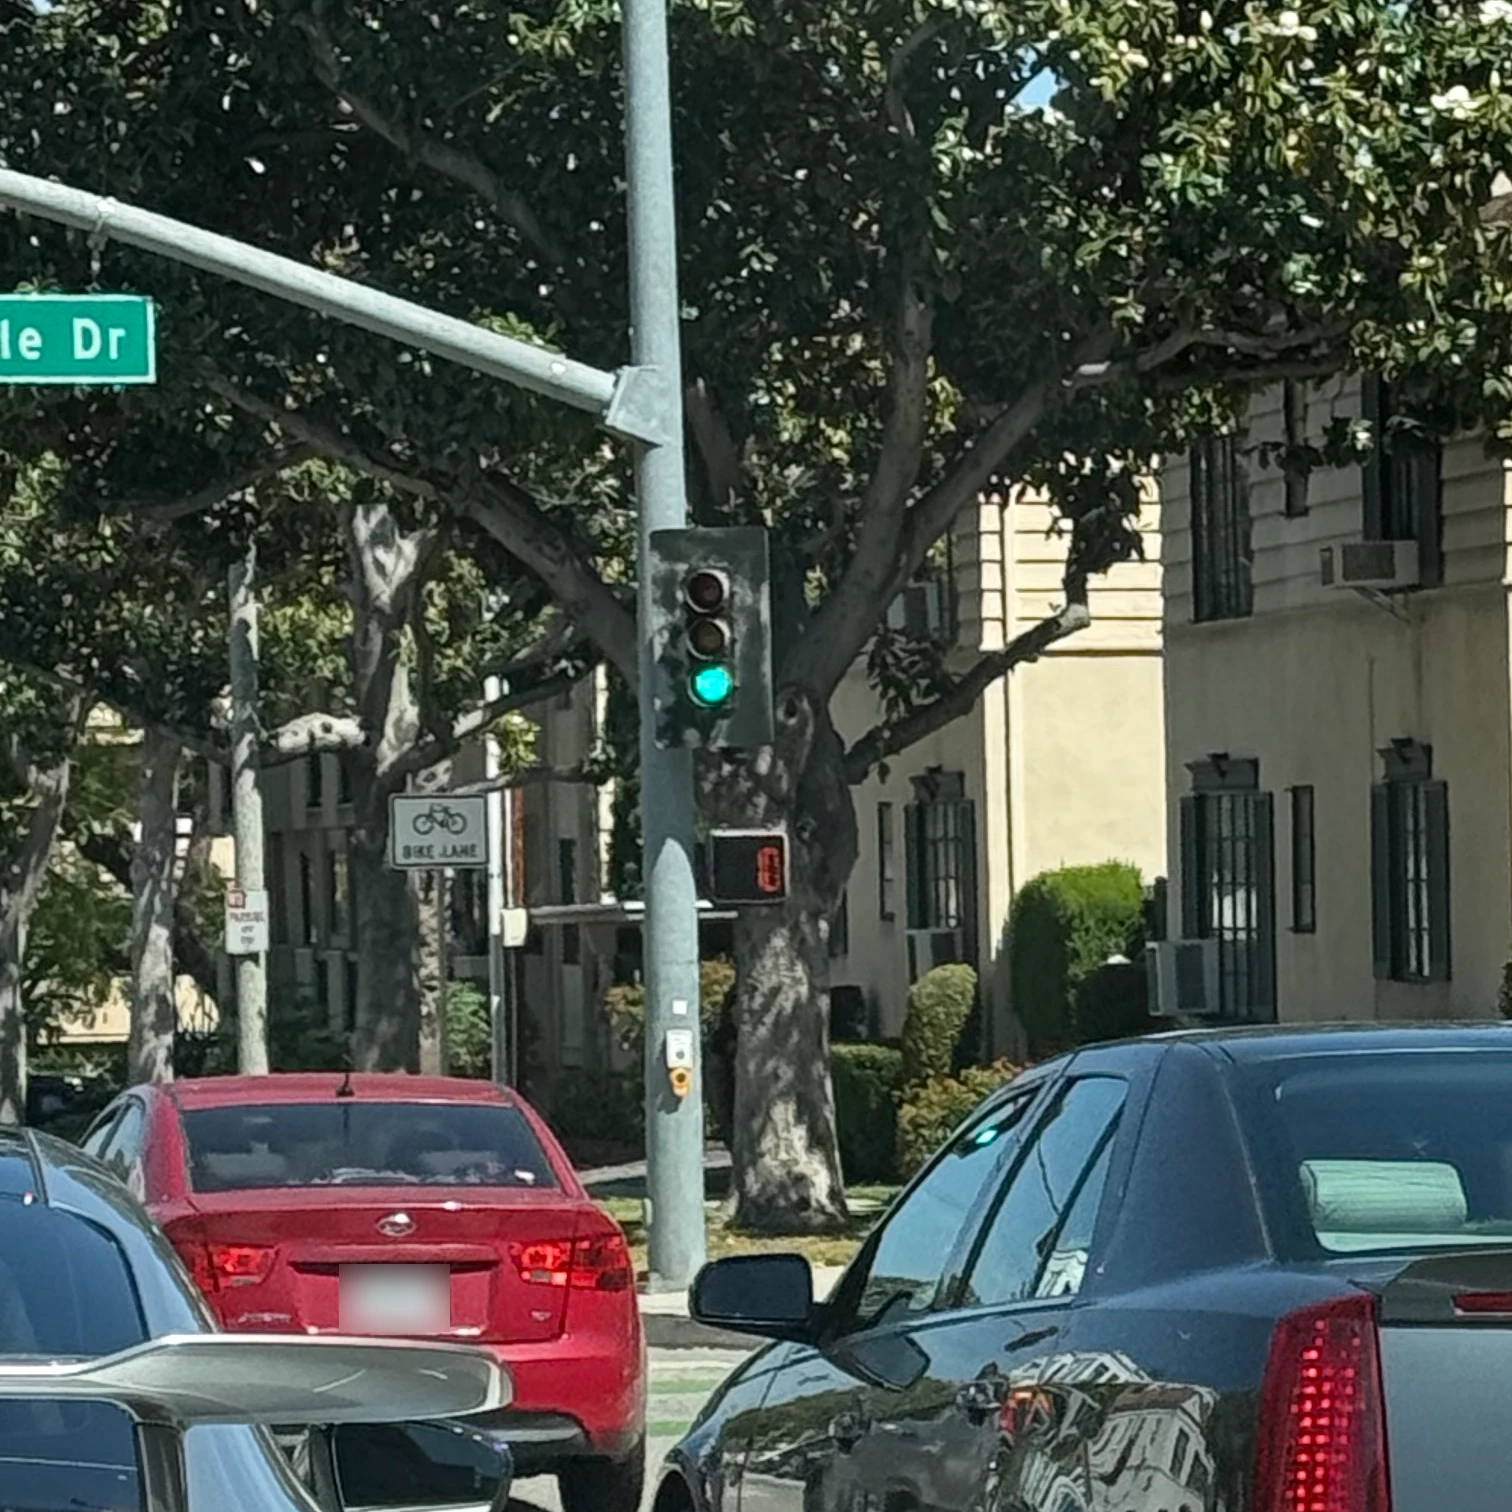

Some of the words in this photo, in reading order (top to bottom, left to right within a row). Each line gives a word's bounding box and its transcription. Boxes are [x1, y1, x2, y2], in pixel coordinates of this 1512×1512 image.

[72, 317, 127, 361] Dr
[402, 844, 434, 860] BIKE
[439, 843, 478, 859] LANE
